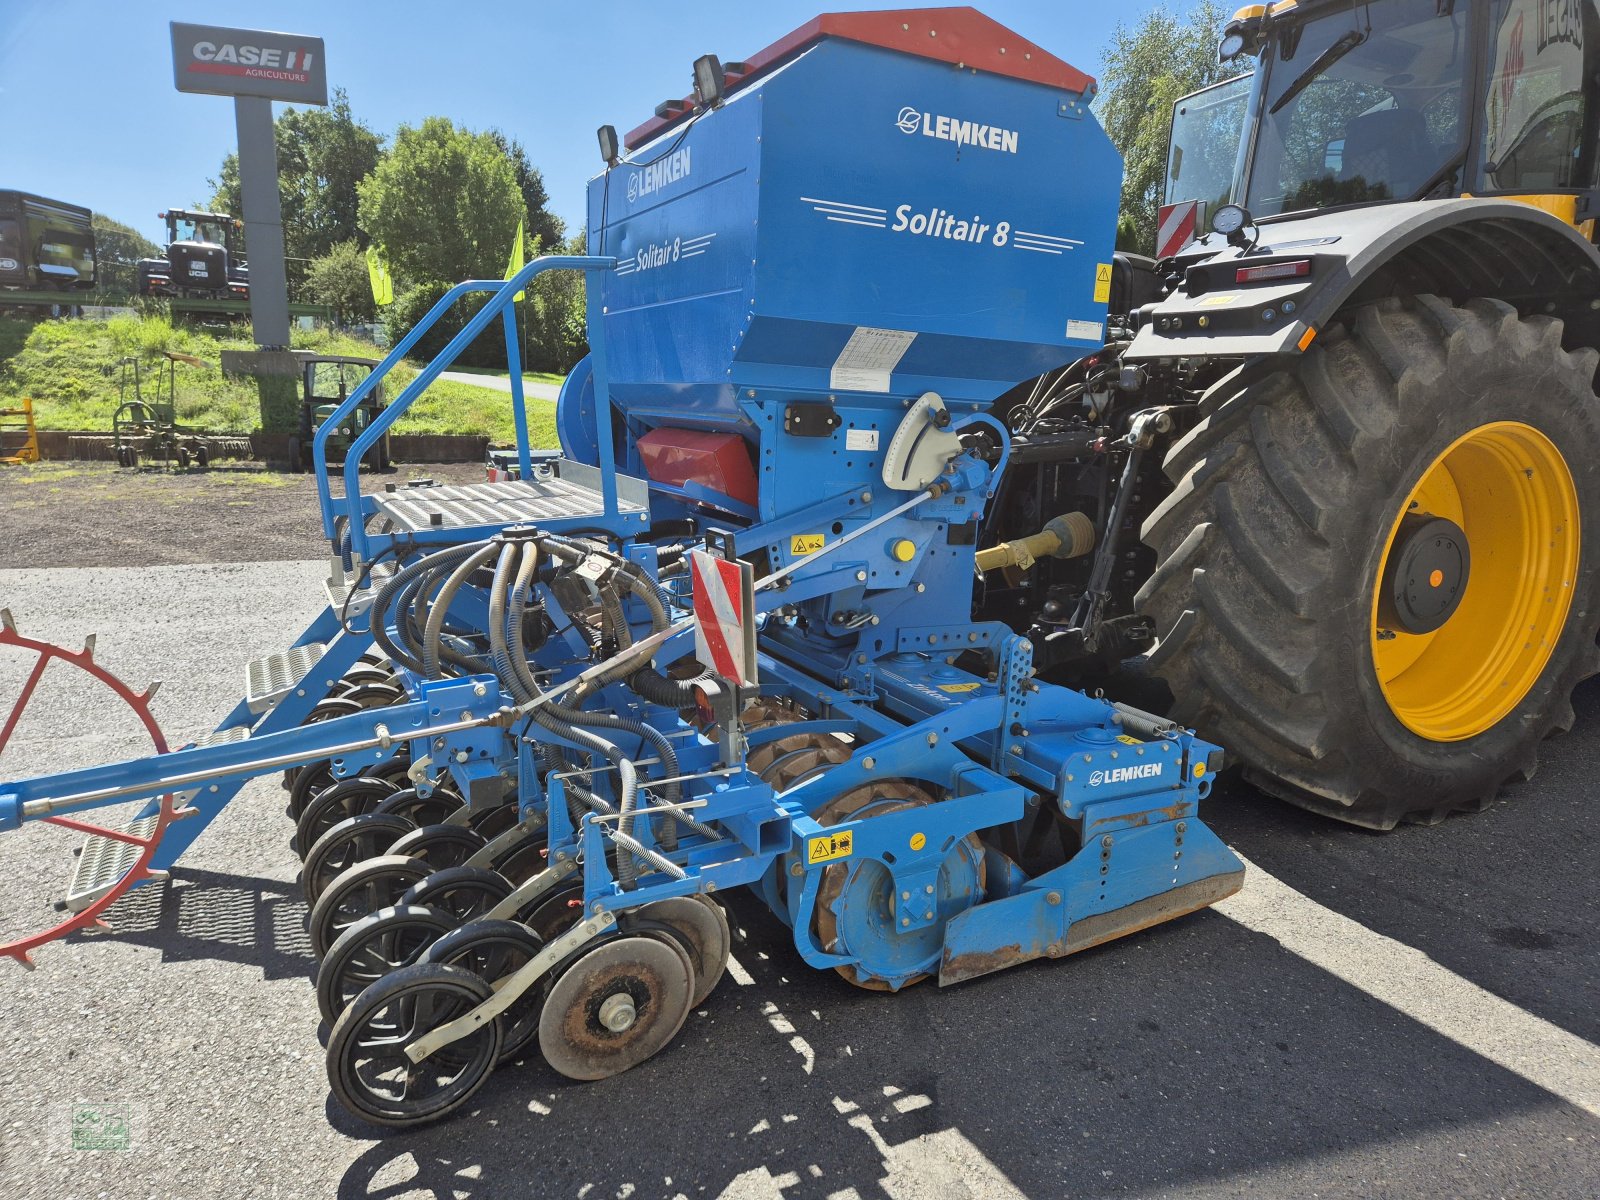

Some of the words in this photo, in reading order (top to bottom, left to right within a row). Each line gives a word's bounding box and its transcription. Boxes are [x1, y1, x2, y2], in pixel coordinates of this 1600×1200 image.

[192, 41, 282, 67] CASE
[245, 68, 306, 82] AGRICULTURE
[922, 112, 1019, 154] LEMKEN
[638, 146, 691, 197] LEMKEN
[891, 204, 990, 243] Solitair
[992, 221, 1011, 247] 8
[635, 239, 673, 272] Solitair
[673, 236, 682, 262] 8
[1103, 762, 1163, 784] LEMKEN
